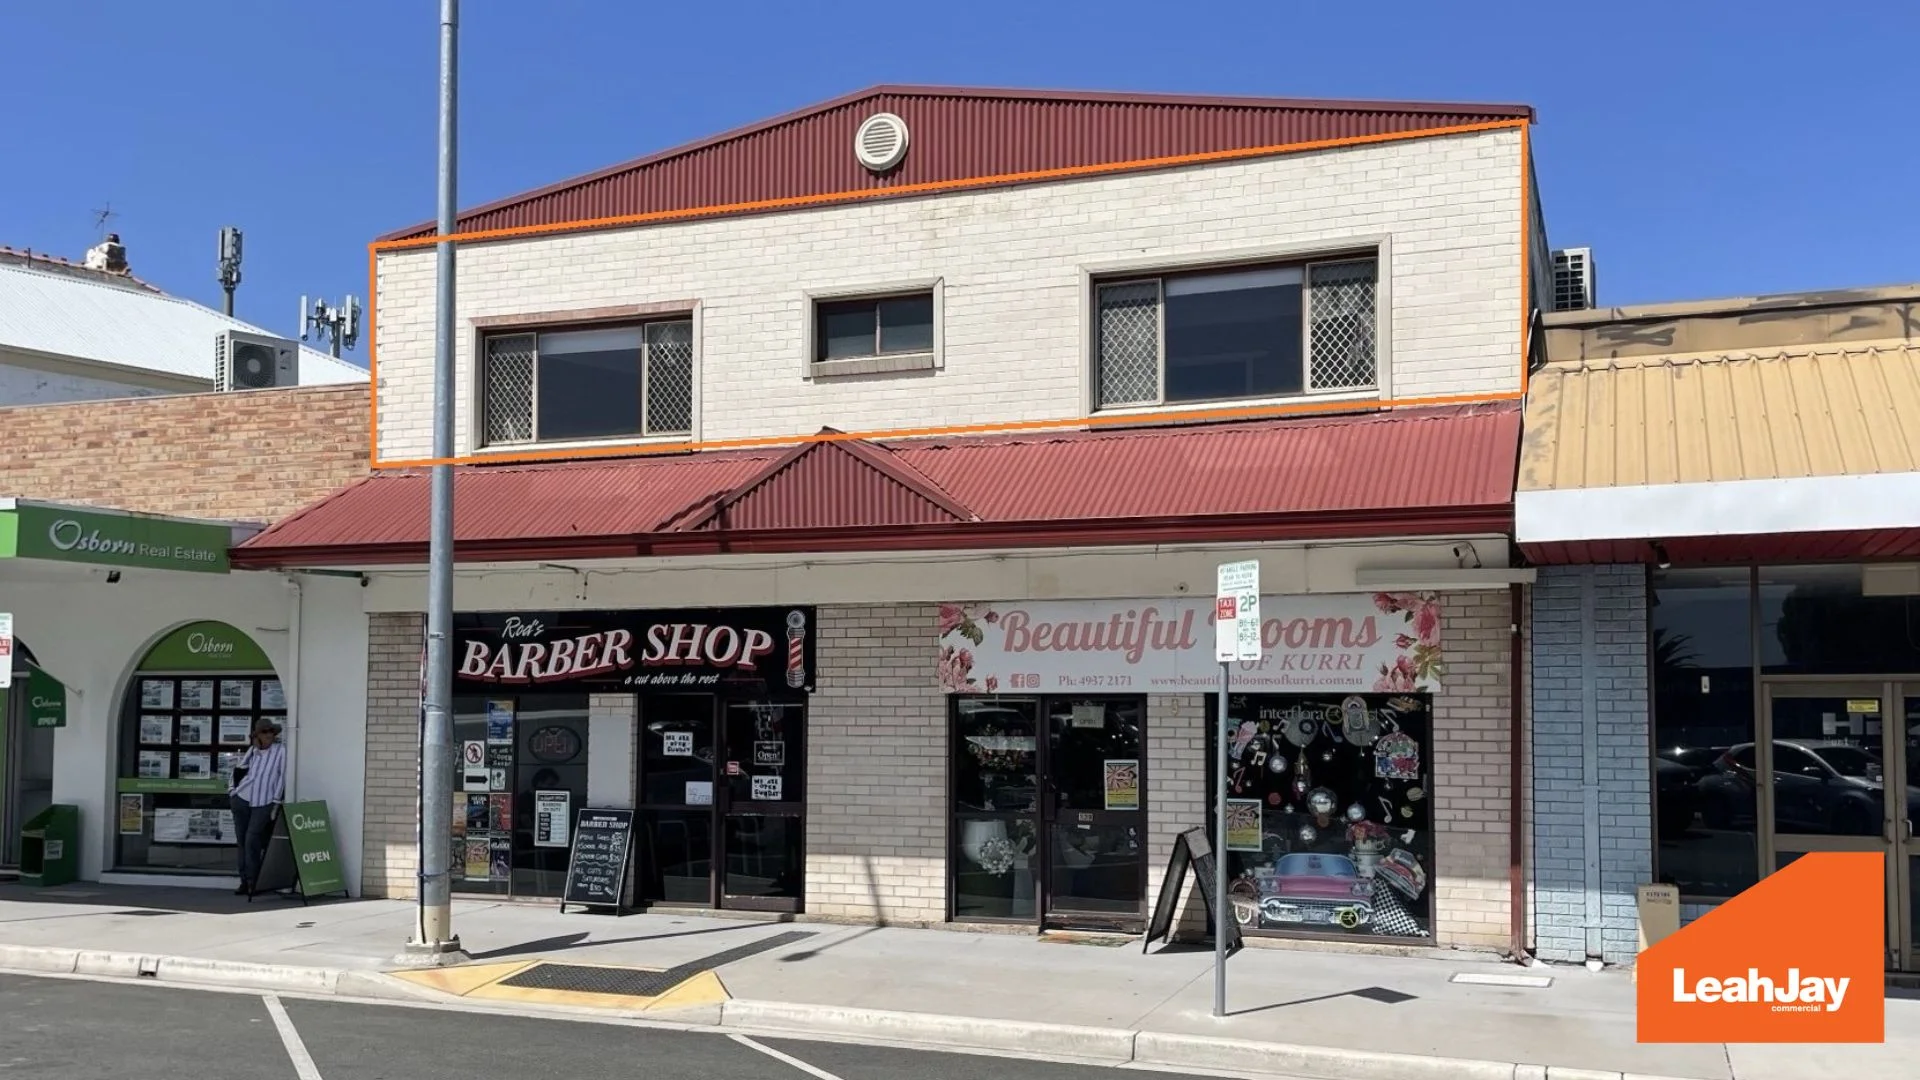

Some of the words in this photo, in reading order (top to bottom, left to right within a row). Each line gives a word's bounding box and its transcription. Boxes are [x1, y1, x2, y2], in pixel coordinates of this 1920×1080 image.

[49, 519, 135, 555] Osborn
[140, 543, 170, 558] Real
[175, 546, 216, 563] Estate
[1219, 598, 1235, 608] TAXI
[1239, 595, 1257, 612] 2P
[1219, 608, 1234, 618] ZONE
[502, 615, 545, 640] Rod's
[1000, 607, 1198, 664] Beautiful
[187, 632, 233, 653] Osborn
[458, 628, 634, 682] BARBER
[641, 623, 773, 669] SHOP
[1240, 654, 1273, 671] OF
[1280, 653, 1364, 671] KURRI
[624, 676, 632, 685] a
[634, 674, 649, 685] cut
[650, 673, 680, 685] above
[681, 672, 696, 684] the
[698, 673, 719, 685] rest
[1058, 675, 1077, 687] Ph:
[1078, 675, 1104, 687] 4937
[1106, 675, 1133, 686] 2171
[1259, 705, 1325, 720] interflora
[580, 820, 608, 828] BARBER
[608, 821, 628, 829] SHOP
[302, 851, 331, 863] OPEN
